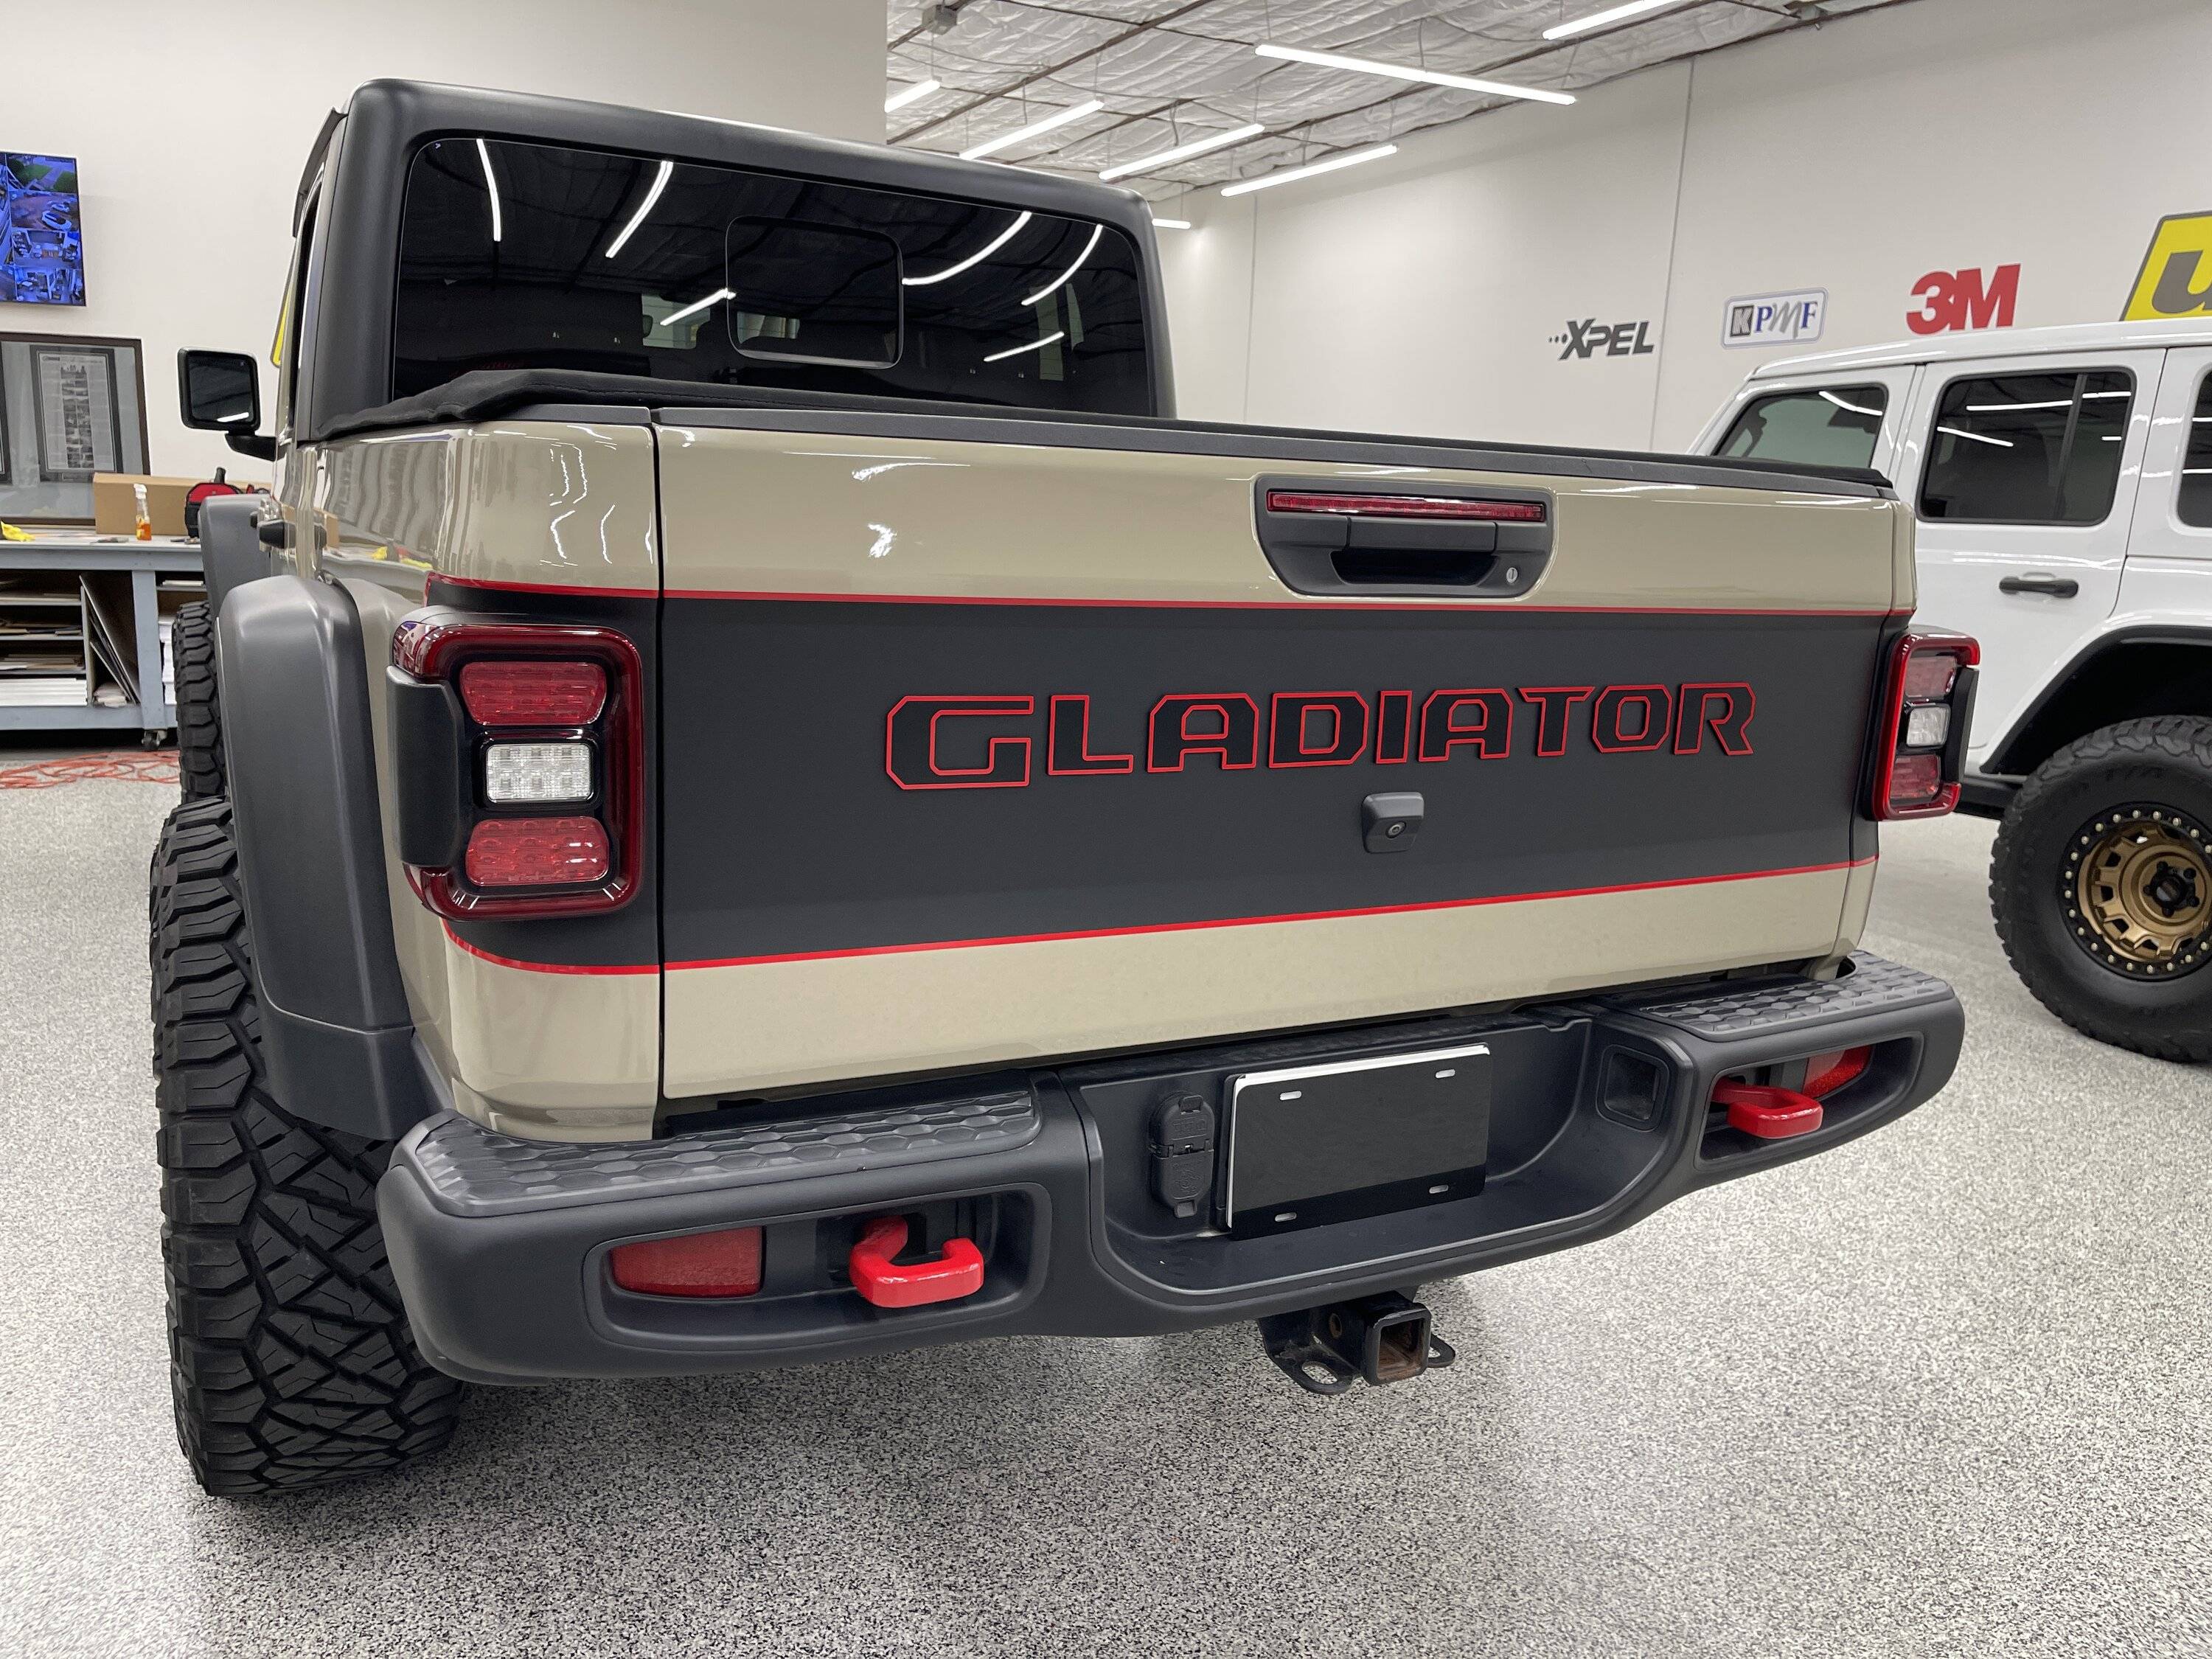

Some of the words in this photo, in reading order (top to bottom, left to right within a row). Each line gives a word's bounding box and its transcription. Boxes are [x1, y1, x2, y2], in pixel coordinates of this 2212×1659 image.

[1730, 302, 1818, 339] KPMF
[1906, 263, 2021, 335] 3M
[1559, 318, 1655, 361] XPEL
[886, 683, 1756, 790] GLADIATOR
